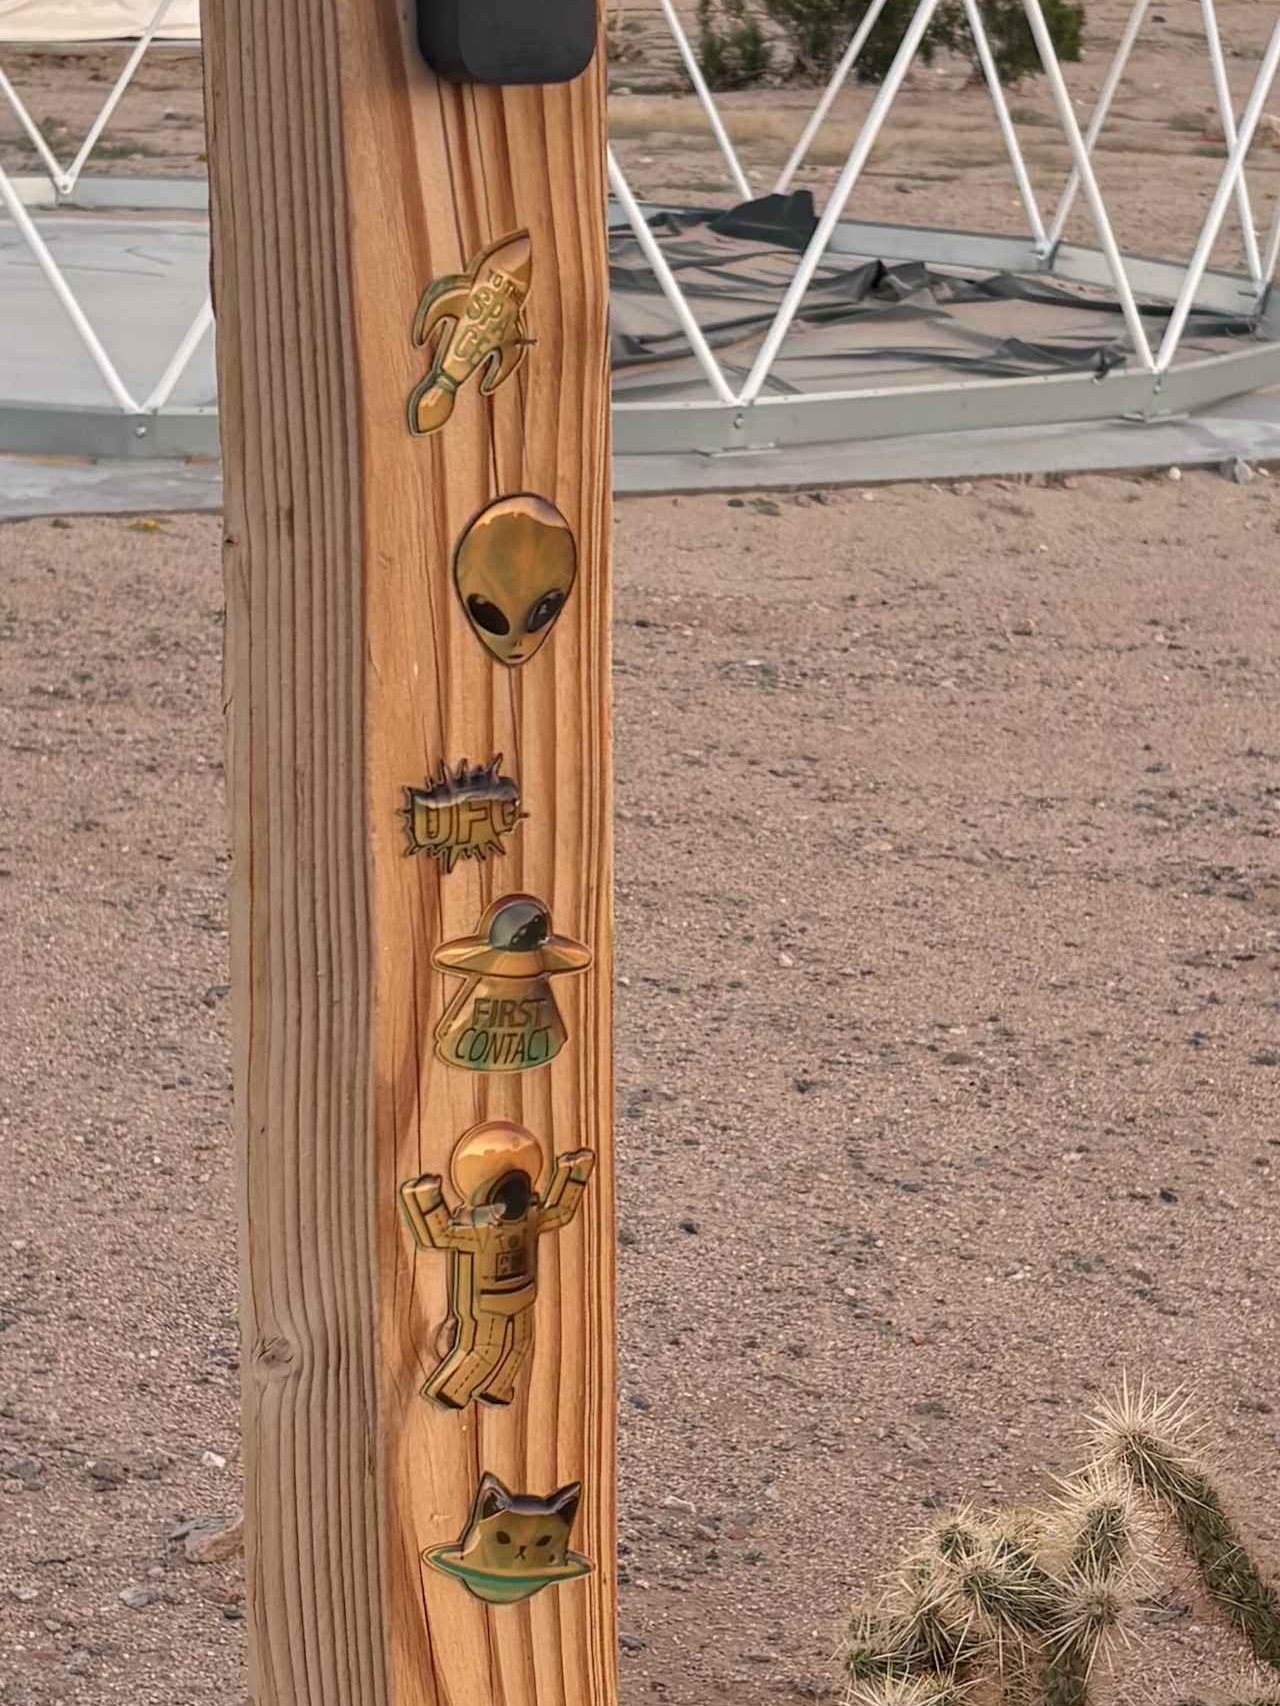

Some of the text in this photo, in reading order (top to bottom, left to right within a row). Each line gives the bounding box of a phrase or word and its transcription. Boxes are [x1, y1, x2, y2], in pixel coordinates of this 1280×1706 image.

[487, 268, 505, 288] TO
[471, 997, 548, 1028] FIRST
[455, 1026, 553, 1064] CONTACT
